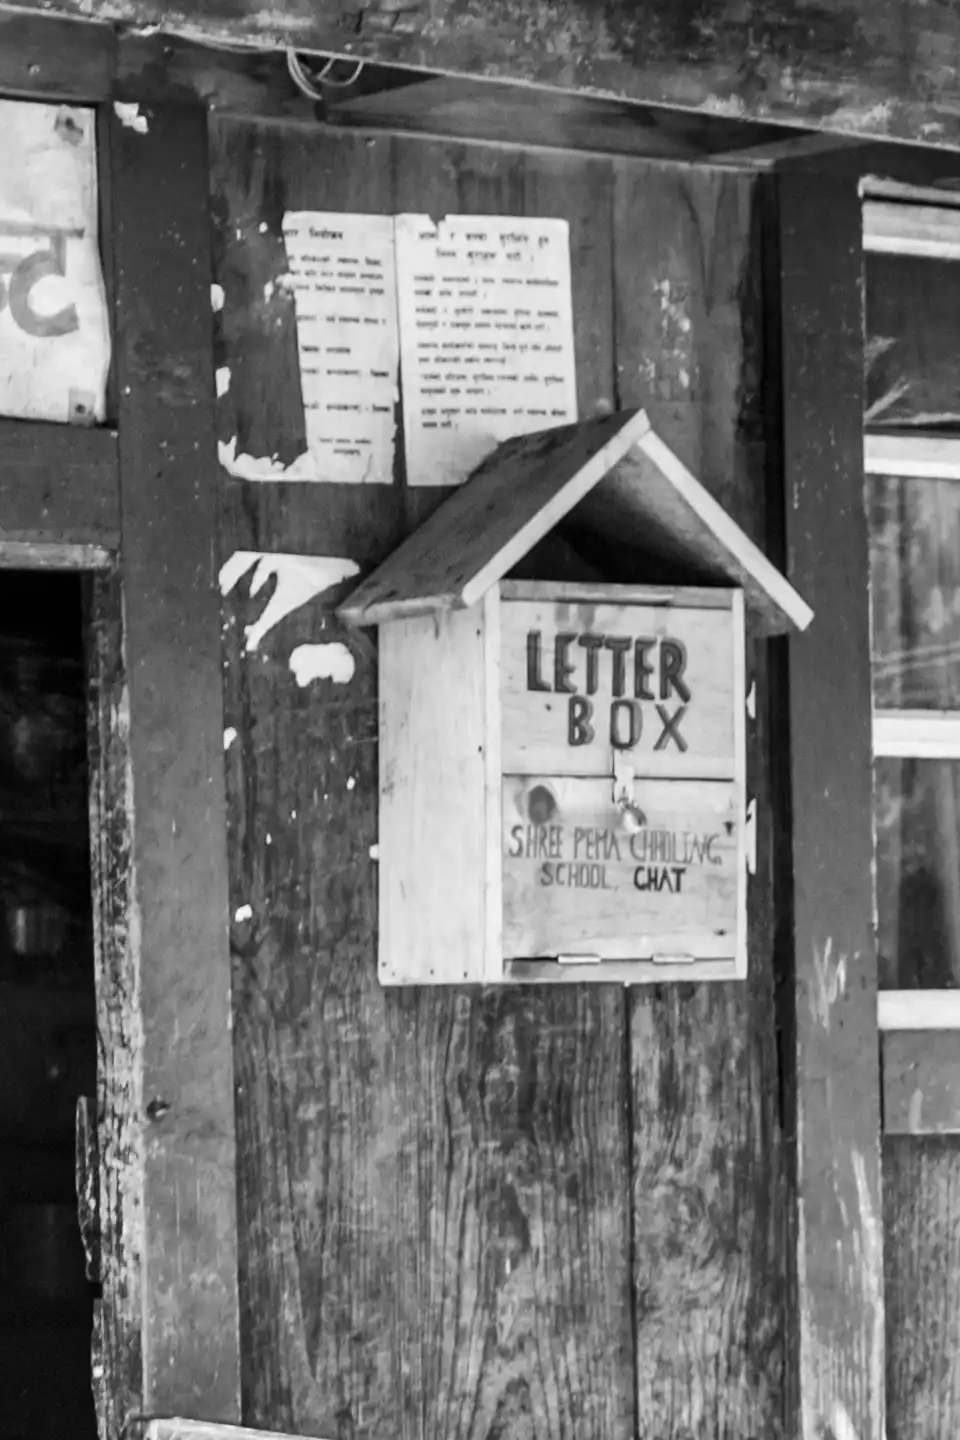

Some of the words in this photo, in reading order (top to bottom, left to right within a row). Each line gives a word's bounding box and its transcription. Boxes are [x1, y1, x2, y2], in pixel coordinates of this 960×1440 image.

[526, 630, 691, 703] LETTER
[568, 695, 689, 752] BOX
[509, 824, 564, 859] SHREE
[574, 827, 622, 862] PEMA
[633, 865, 687, 893] CHAT
